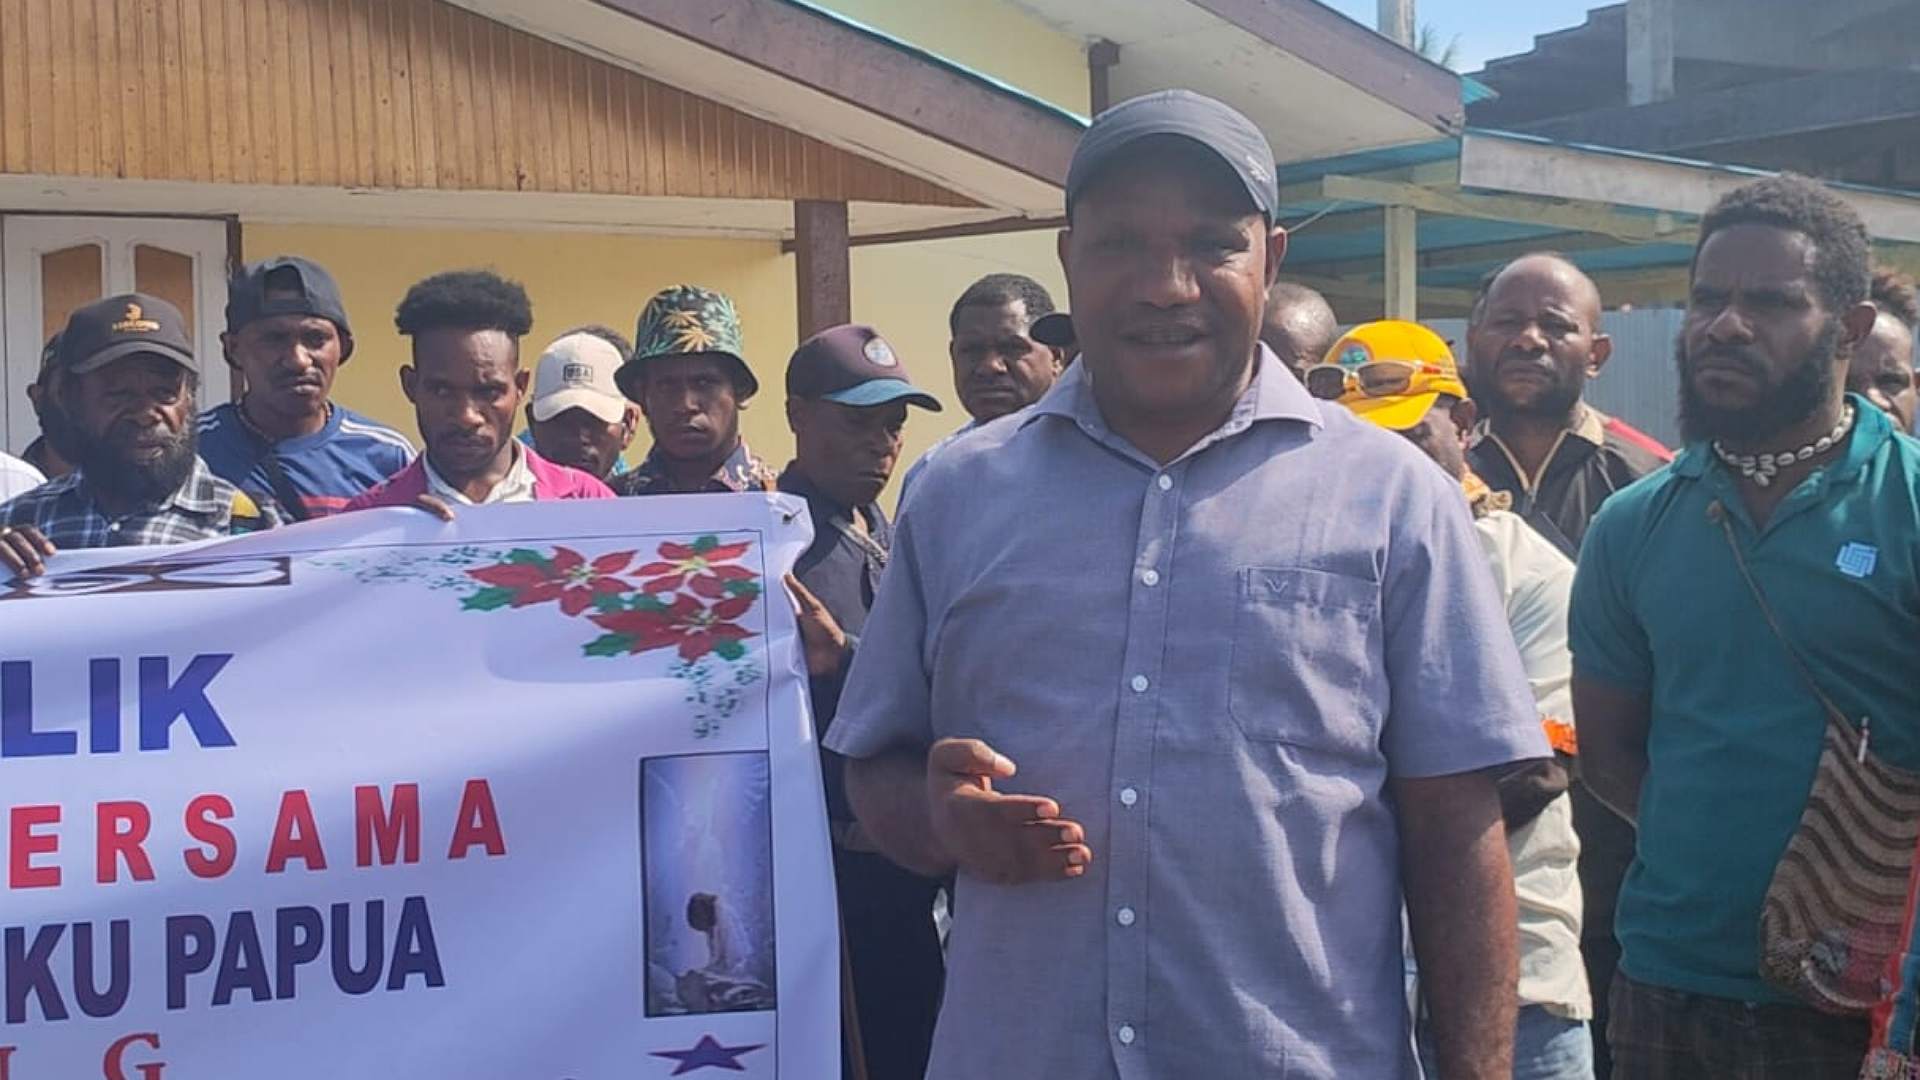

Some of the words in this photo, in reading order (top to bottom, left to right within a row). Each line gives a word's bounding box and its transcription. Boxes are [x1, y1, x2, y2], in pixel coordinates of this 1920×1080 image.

[1, 653, 237, 758] LIK
[9, 778, 506, 890] ERSAMA
[4, 918, 131, 1024] KU
[166, 896, 446, 1010] PAPUA
